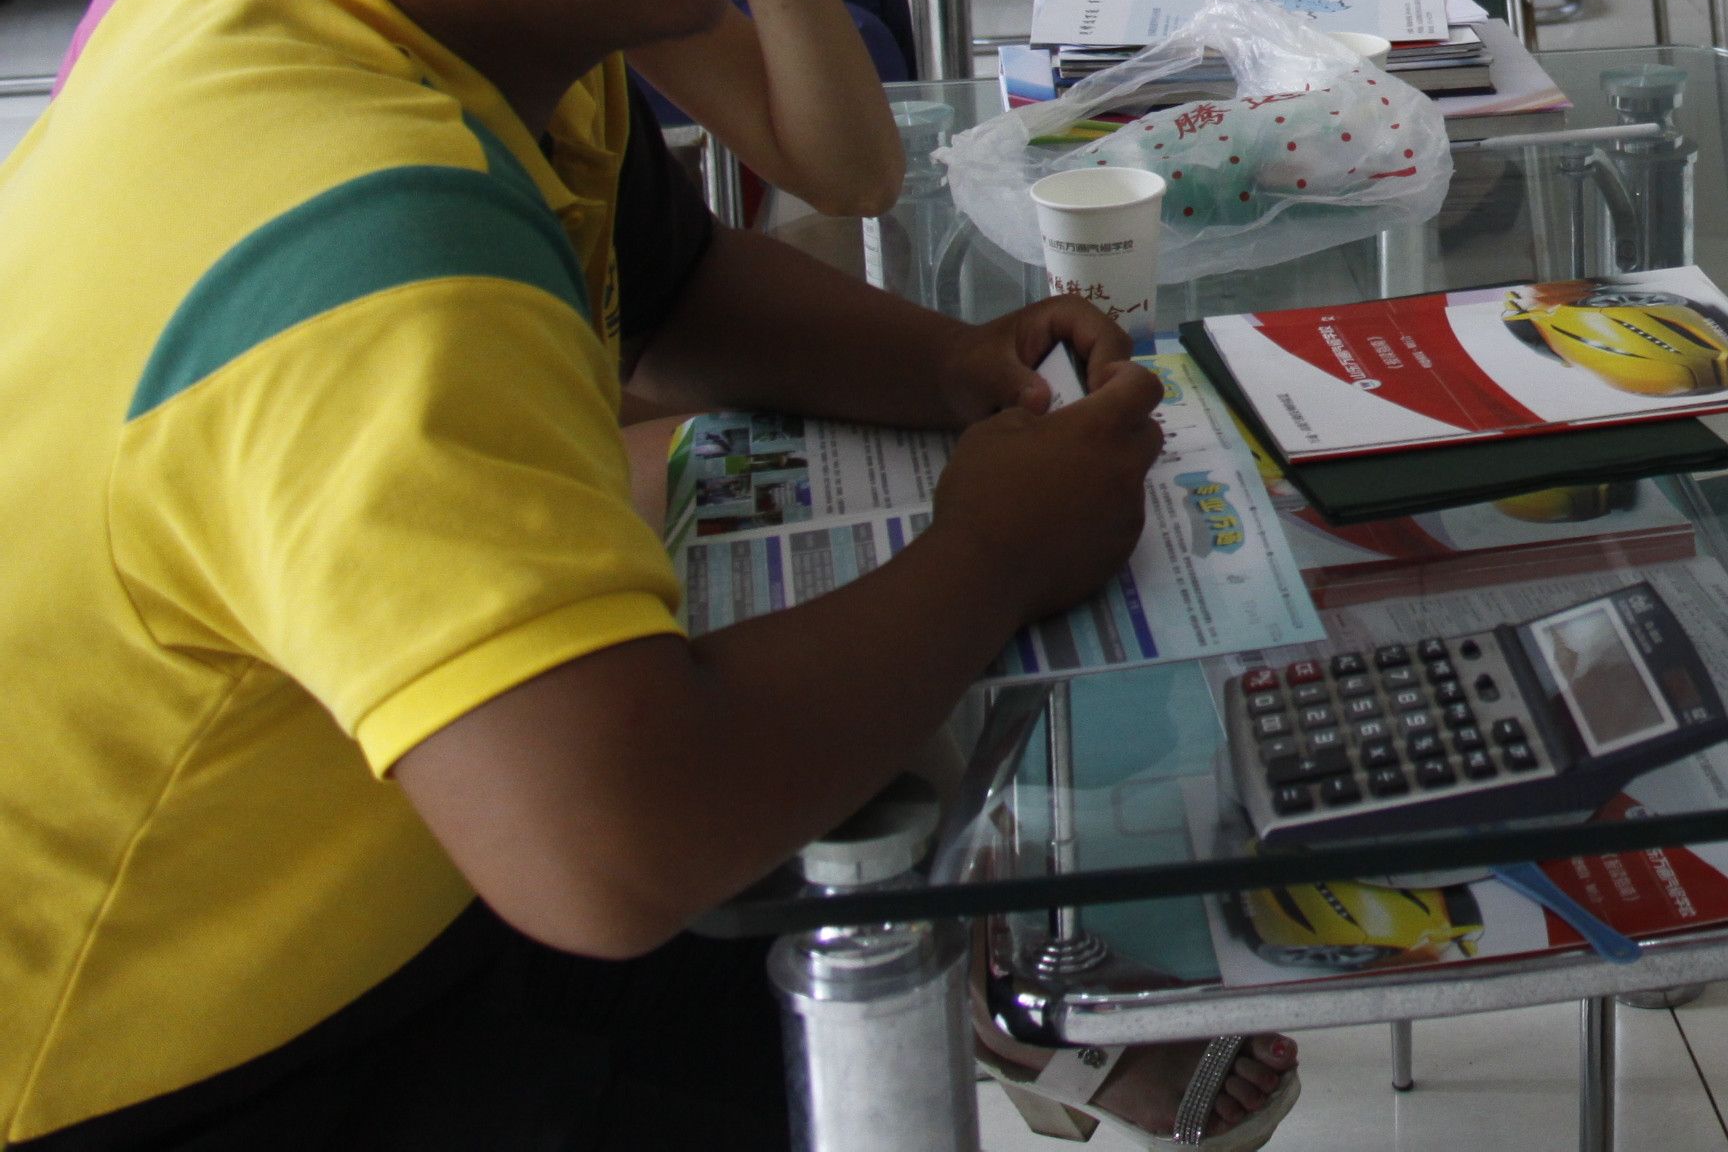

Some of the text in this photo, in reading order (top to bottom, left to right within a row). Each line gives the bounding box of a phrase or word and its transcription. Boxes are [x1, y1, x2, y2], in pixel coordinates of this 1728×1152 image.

[1352, 699, 1373, 712] 5
[1306, 709, 1327, 721] 2
[1360, 722, 1381, 736] 6
[1314, 732, 1335, 744] 3
